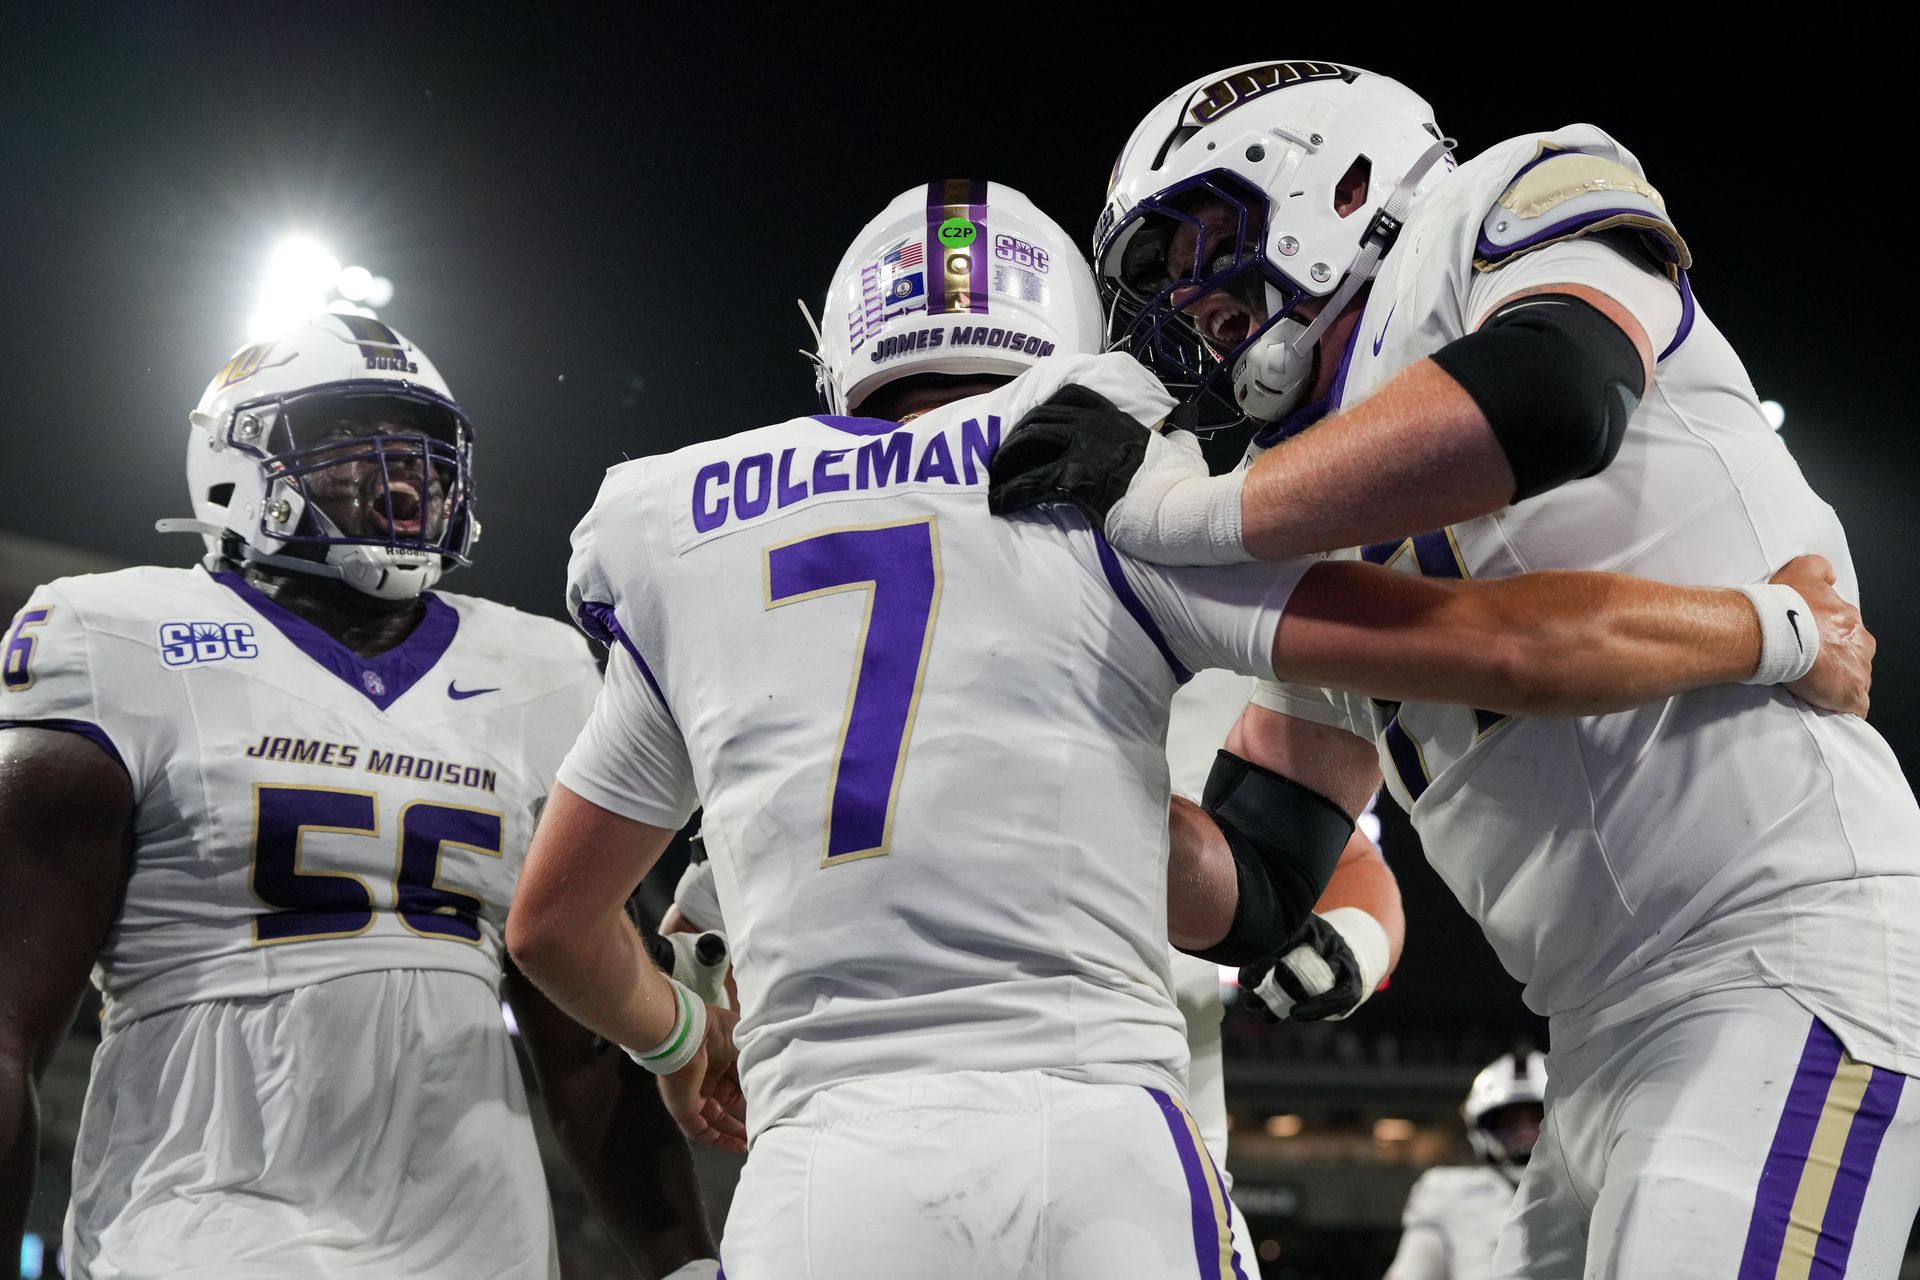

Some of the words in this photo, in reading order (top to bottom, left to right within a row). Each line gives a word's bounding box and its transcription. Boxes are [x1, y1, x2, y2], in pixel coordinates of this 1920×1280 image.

[942, 227, 973, 239] C2P
[995, 234, 1049, 274] SBC
[366, 356, 419, 374] DUKES
[871, 328, 945, 362] JAMES
[951, 326, 1055, 357] MADISON
[692, 415, 1001, 534] COLEMAN
[160, 622, 259, 666] SBC
[762, 514, 944, 869] 7
[244, 736, 358, 768] JAMES
[366, 748, 498, 793] MADISON
[247, 782, 505, 947] 56
